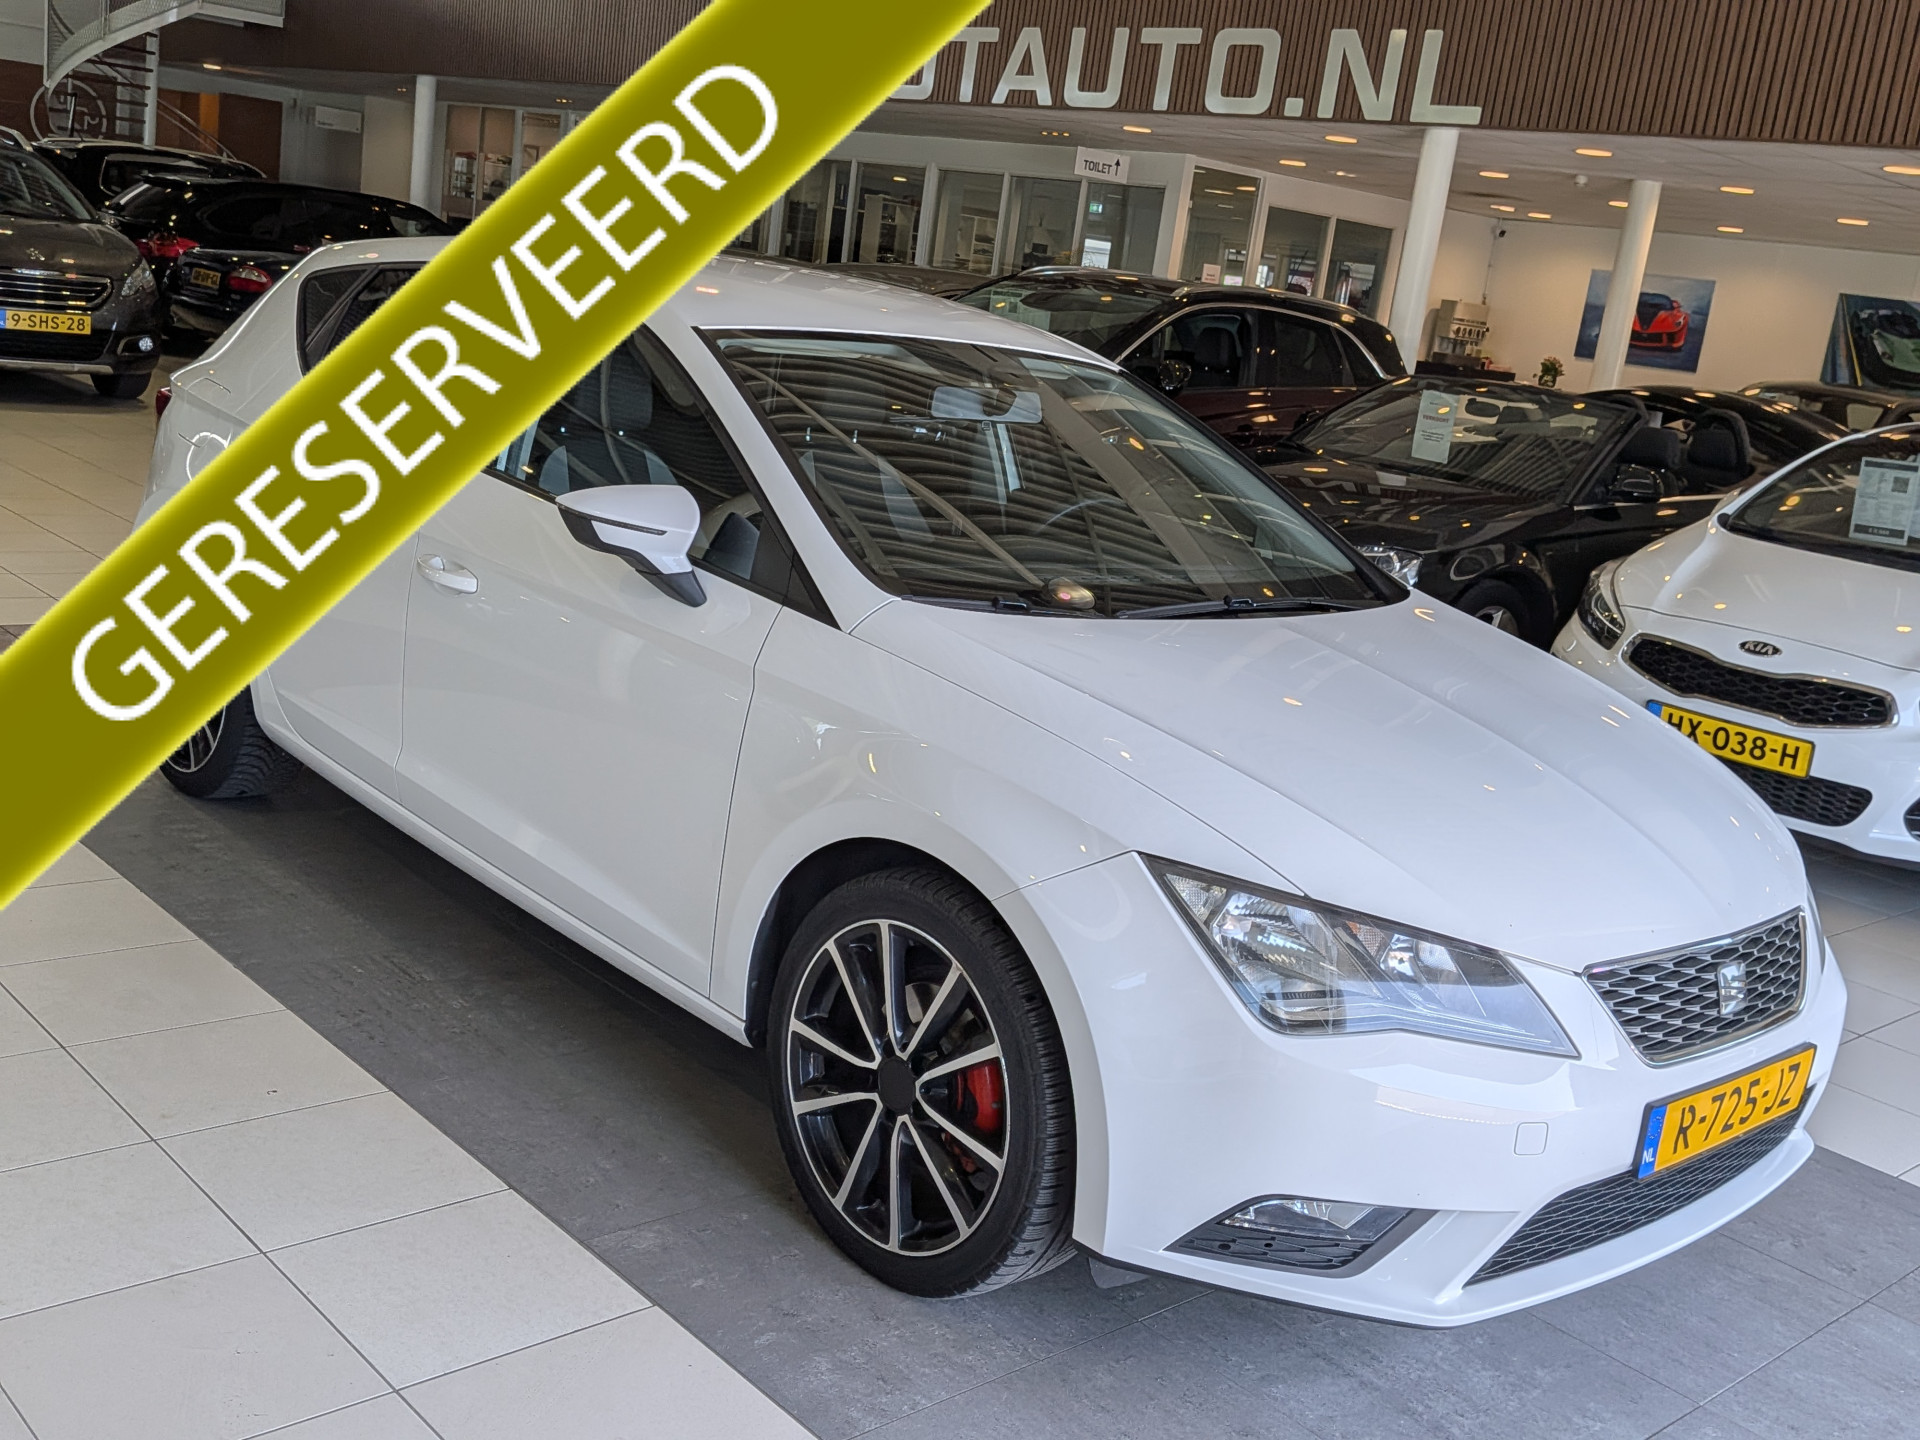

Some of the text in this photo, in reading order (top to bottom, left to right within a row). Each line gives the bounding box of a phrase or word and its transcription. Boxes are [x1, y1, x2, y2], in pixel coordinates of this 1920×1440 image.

[1083, 159, 1113, 175] TOILET
[11, 313, 86, 332] 9-SHS-28
[1743, 641, 1774, 655] KIA
[1673, 1061, 1802, 1155] R-725-JZ
[1641, 1147, 1656, 1165] NL
